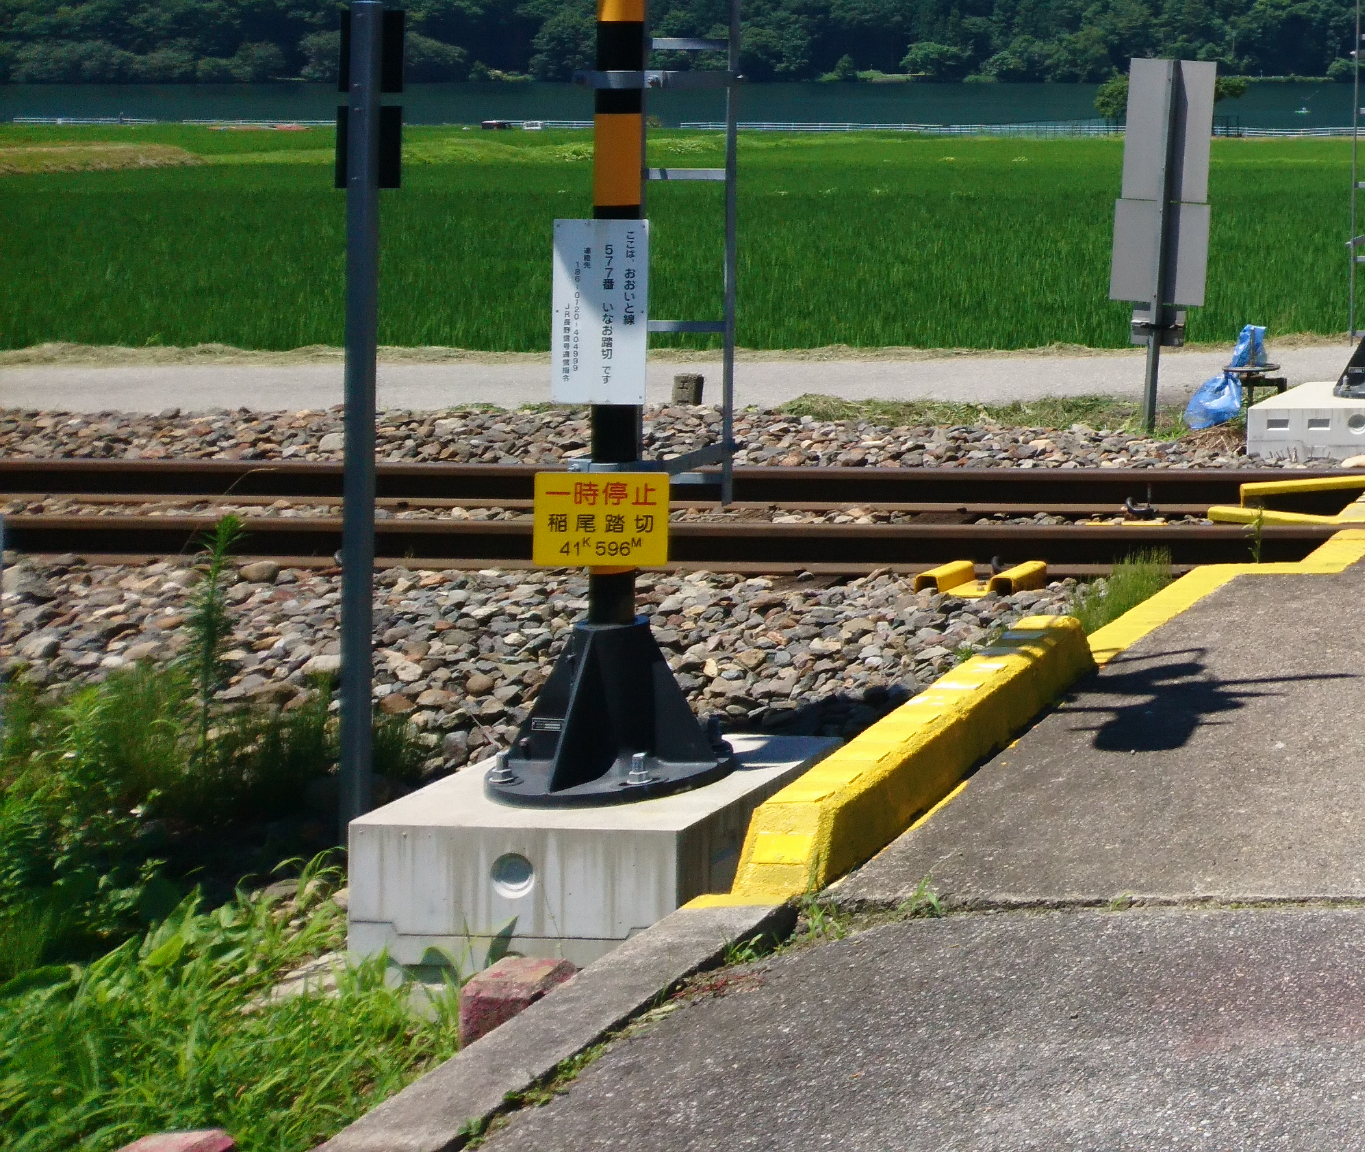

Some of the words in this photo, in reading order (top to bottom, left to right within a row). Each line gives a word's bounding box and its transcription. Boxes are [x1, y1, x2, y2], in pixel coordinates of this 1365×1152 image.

[545, 481, 657, 506] 一時停止
[547, 513, 654, 533] 稲尾踏切
